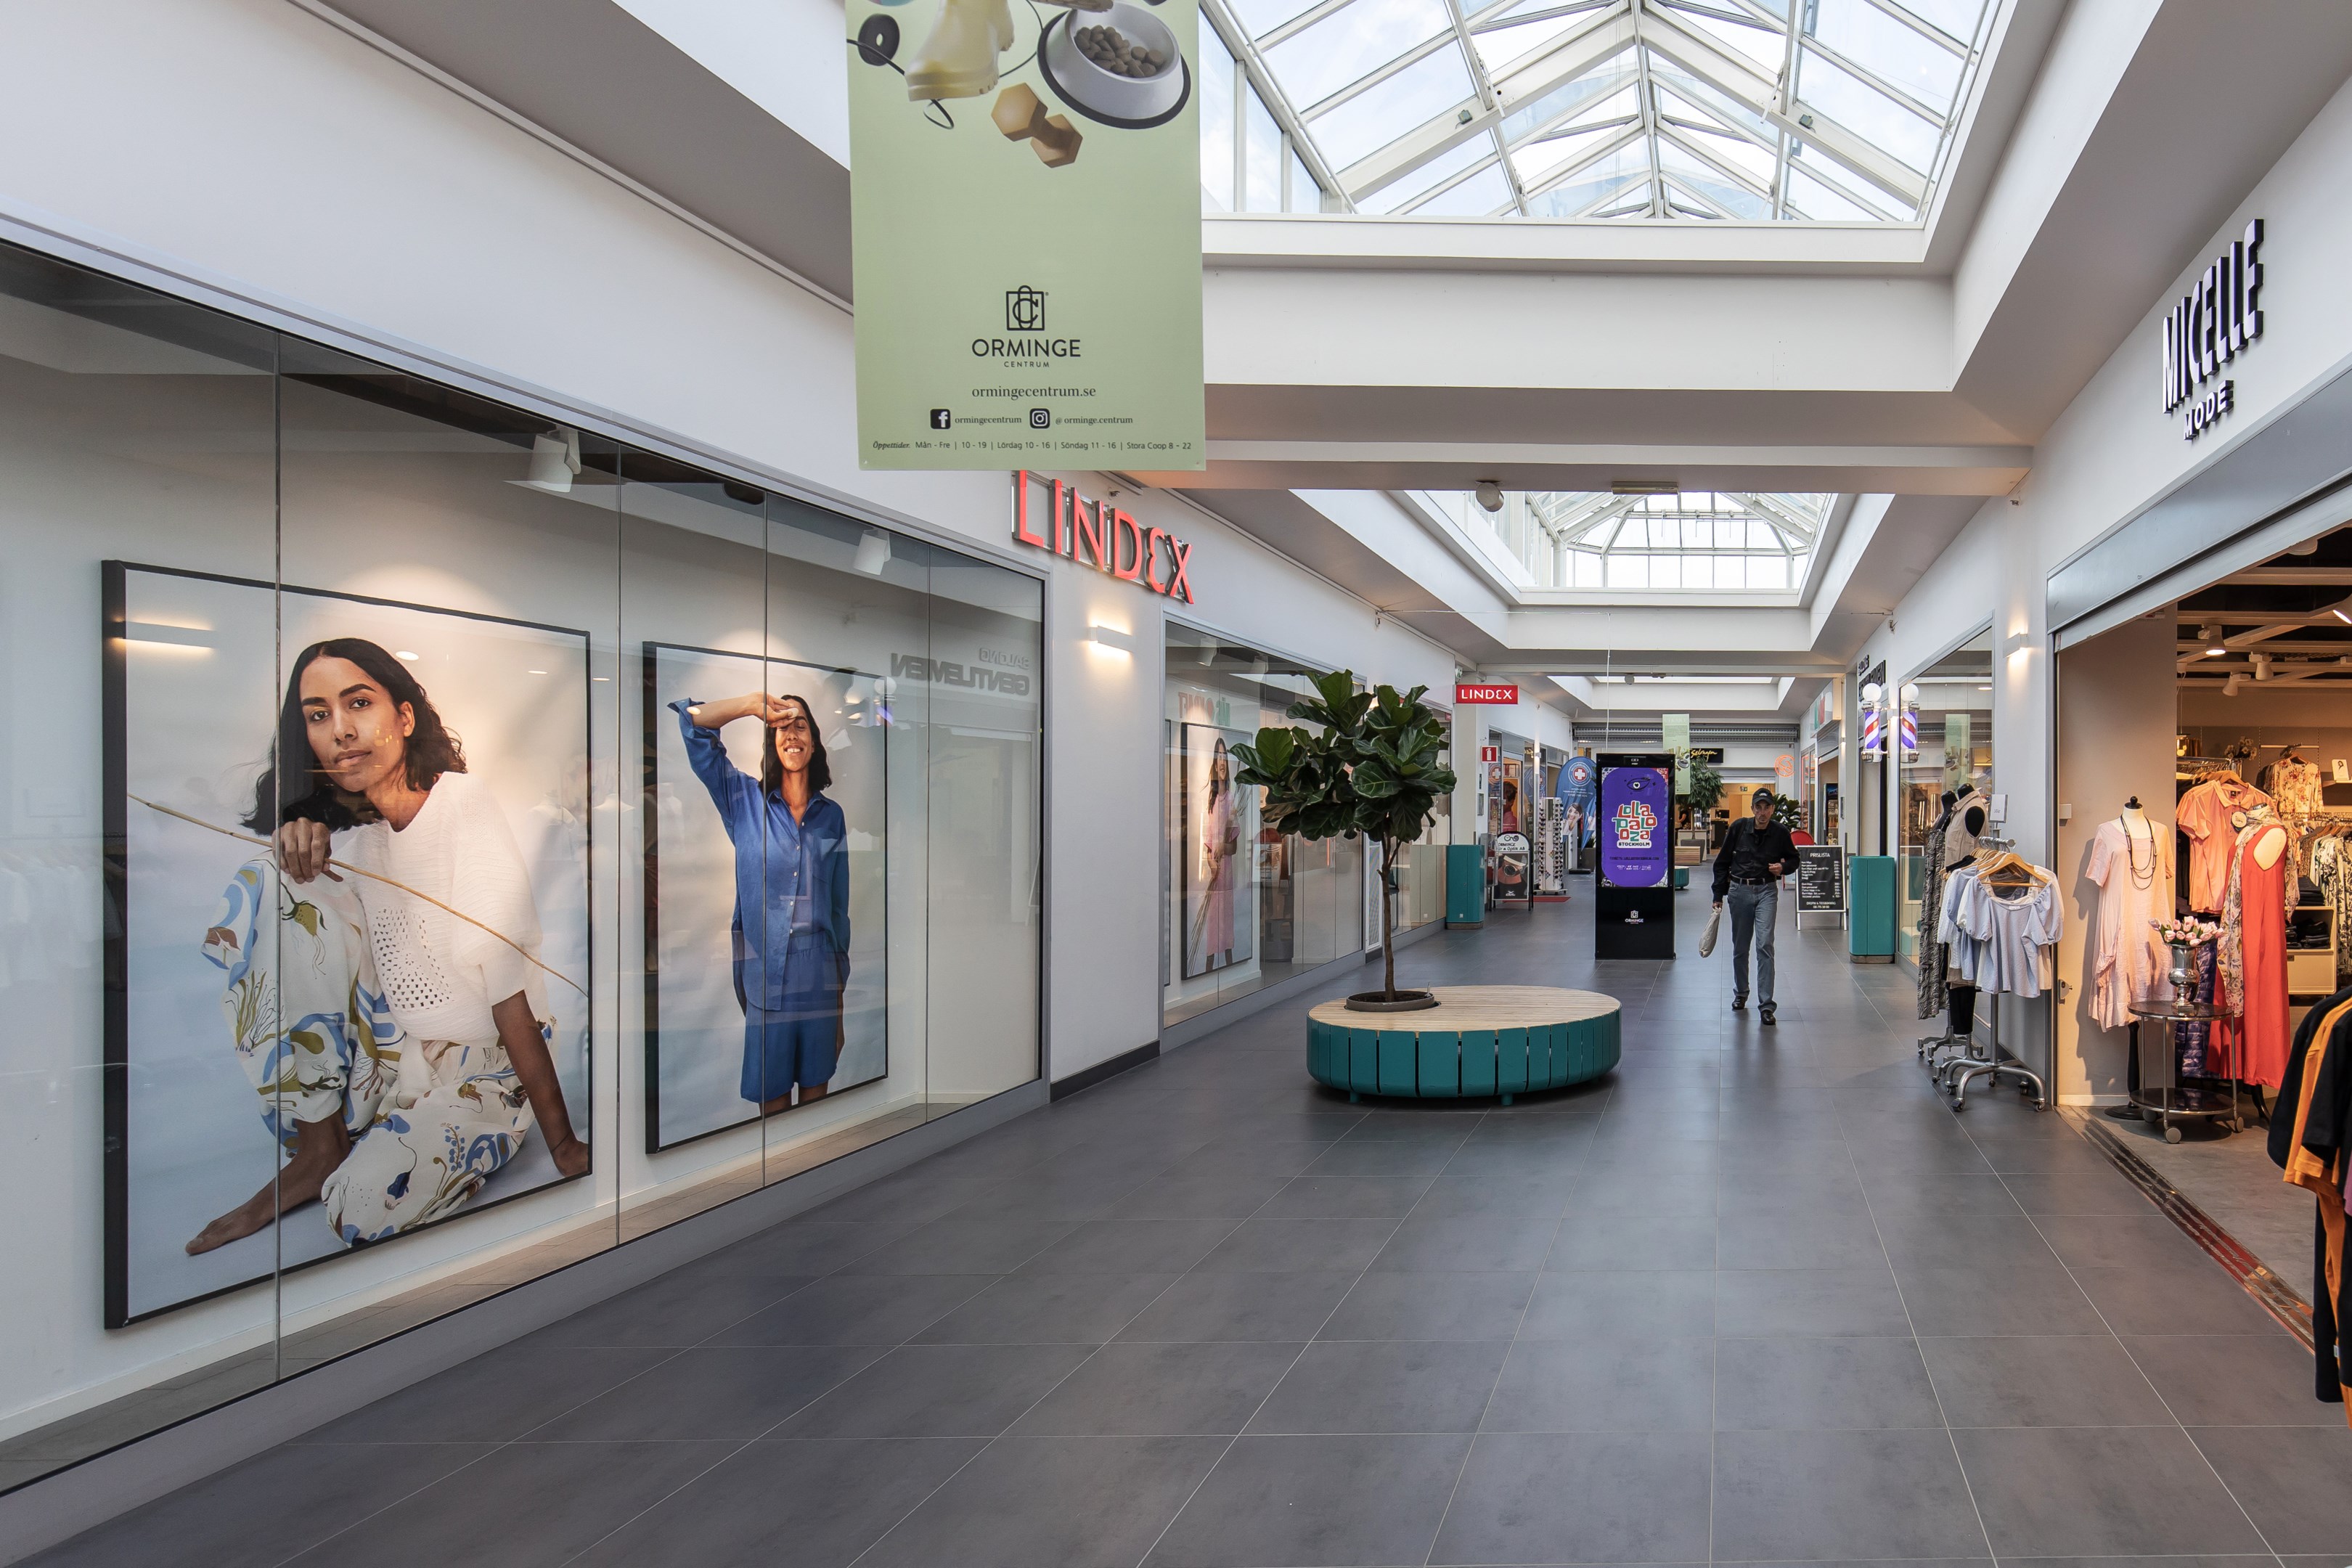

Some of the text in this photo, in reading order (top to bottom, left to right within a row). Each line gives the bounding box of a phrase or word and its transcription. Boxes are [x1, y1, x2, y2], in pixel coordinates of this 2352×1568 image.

[2163, 219, 2264, 414] MICELLE
[971, 338, 1082, 357] ORMINGE
[971, 385, 1096, 401] ormingecentrum.se
[2184, 380, 2234, 441] MODE
[955, 415, 1022, 426] ormingecentrum
[997, 441, 1023, 451] Lördag
[1061, 441, 1089, 451] Söndag
[1147, 441, 1167, 451] Coop
[1016, 470, 1194, 605] LINDEX
[1461, 689, 1513, 700] LINDEX
